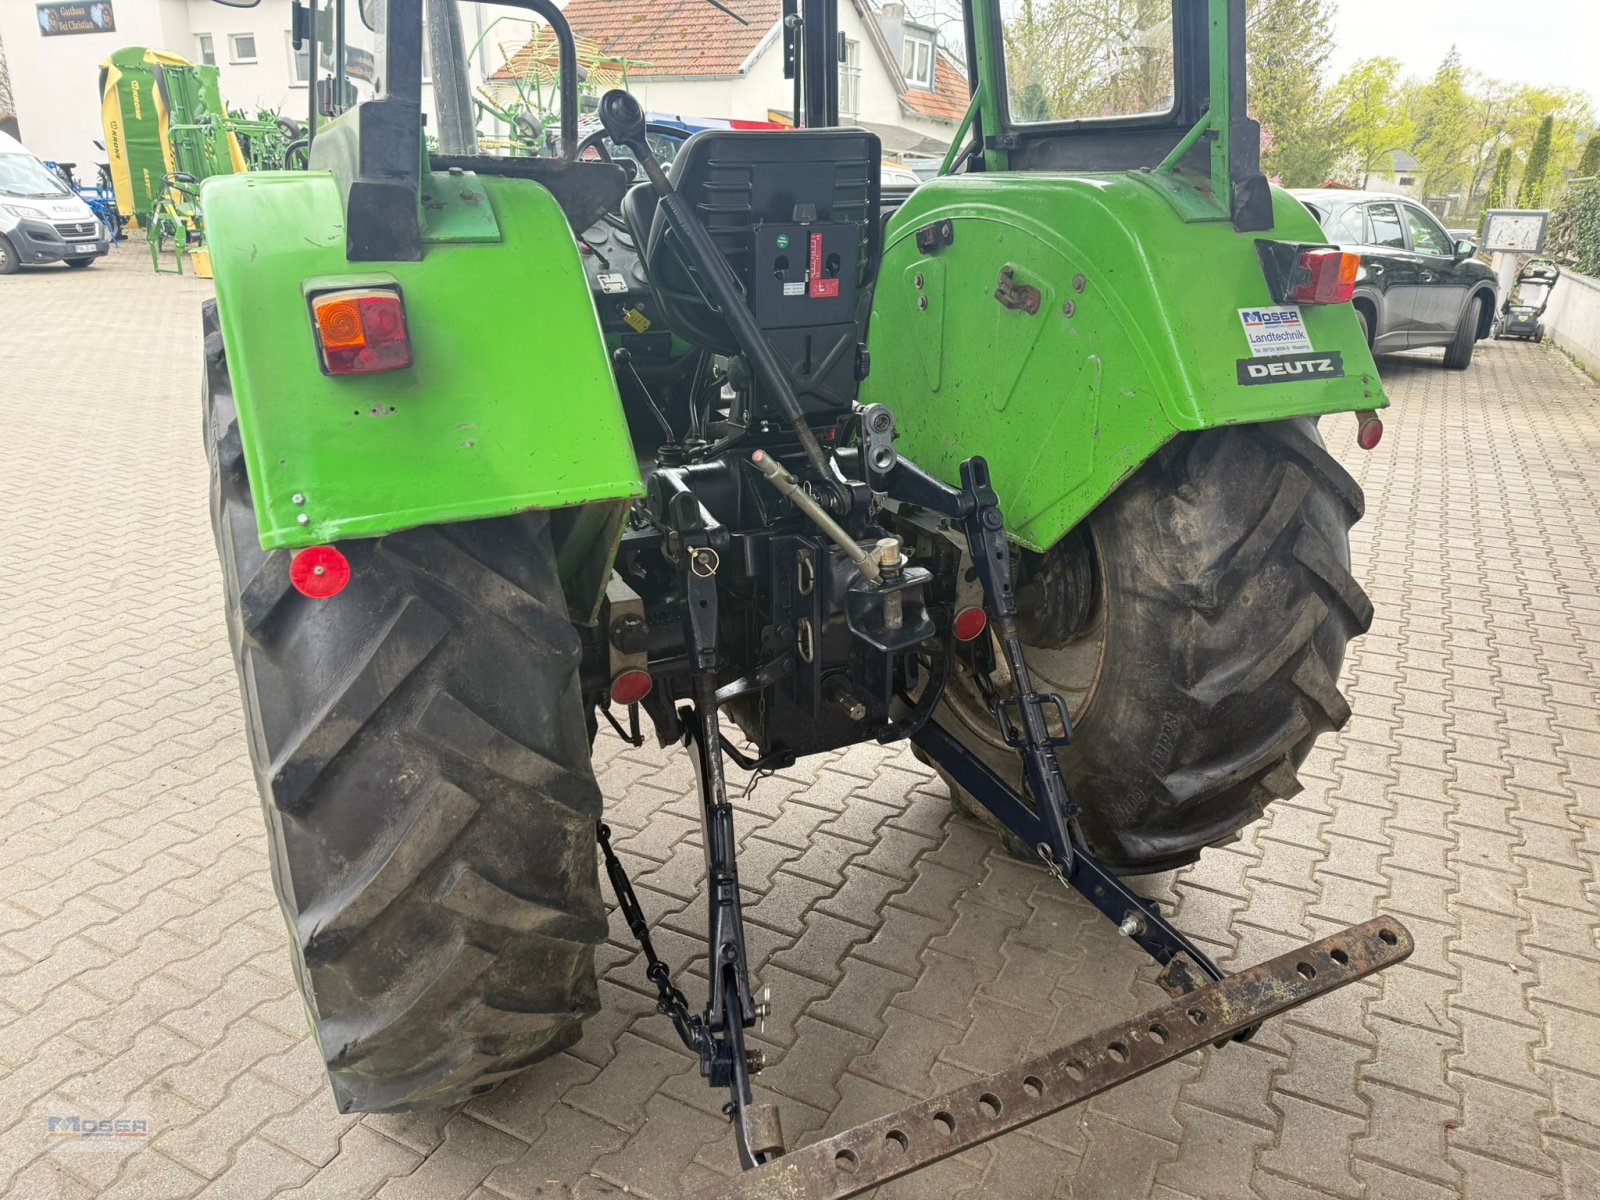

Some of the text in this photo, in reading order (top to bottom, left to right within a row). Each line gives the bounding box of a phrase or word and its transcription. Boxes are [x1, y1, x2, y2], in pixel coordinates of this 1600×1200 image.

[132, 89, 142, 120] KRONE
[111, 131, 121, 160] KRONE
[1242, 311, 1299, 323] MOSER
[1249, 330, 1306, 343] Landtechnik
[1248, 359, 1334, 378] DEUTZ
